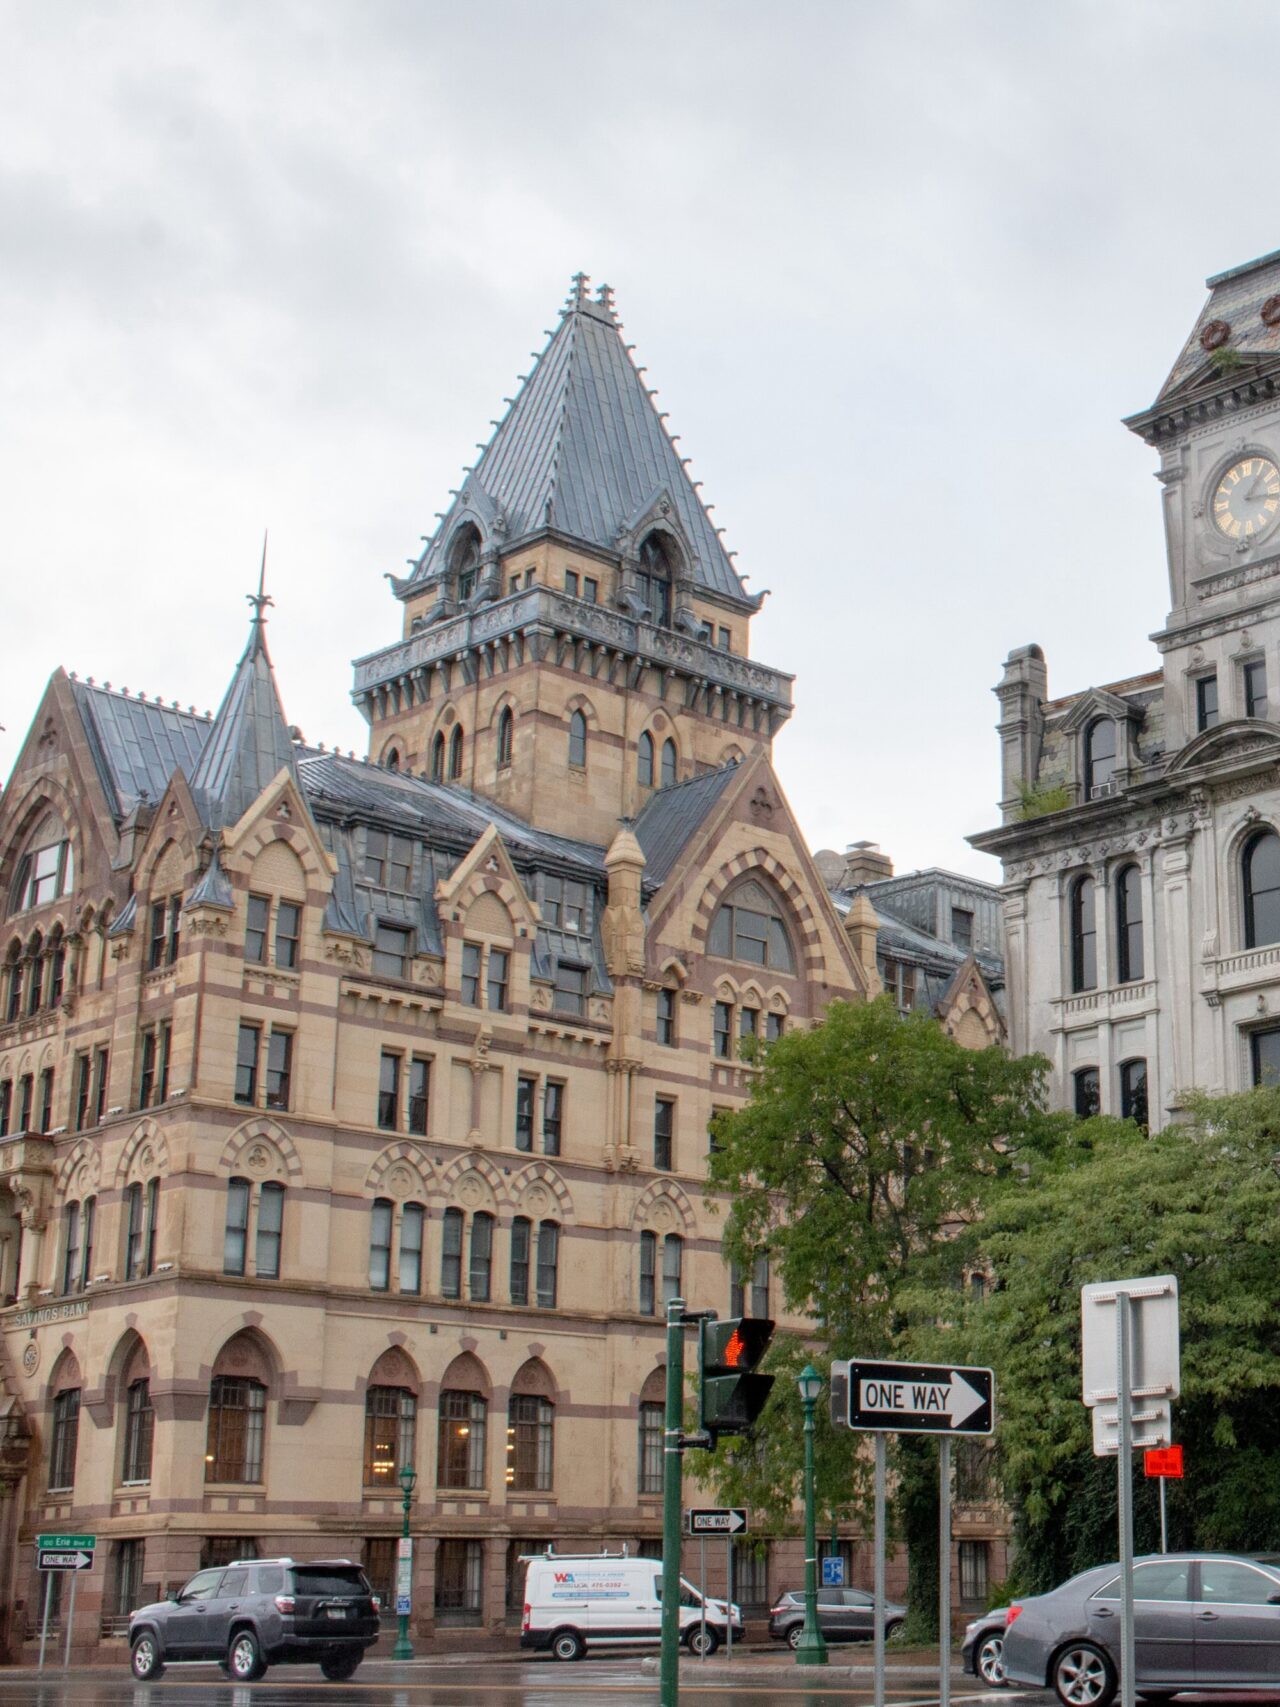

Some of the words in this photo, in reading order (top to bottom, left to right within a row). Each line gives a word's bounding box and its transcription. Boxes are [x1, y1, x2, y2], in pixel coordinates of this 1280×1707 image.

[63, 1301, 90, 1319] BANK
[866, 1383, 904, 1409] ONE
[912, 1385, 951, 1411] WAY
[696, 1517, 712, 1526] ONE
[715, 1517, 730, 1526] WAY
[55, 1538, 70, 1546] Erie
[45, 1556, 60, 1564] ONE
[62, 1556, 77, 1564] WAY
